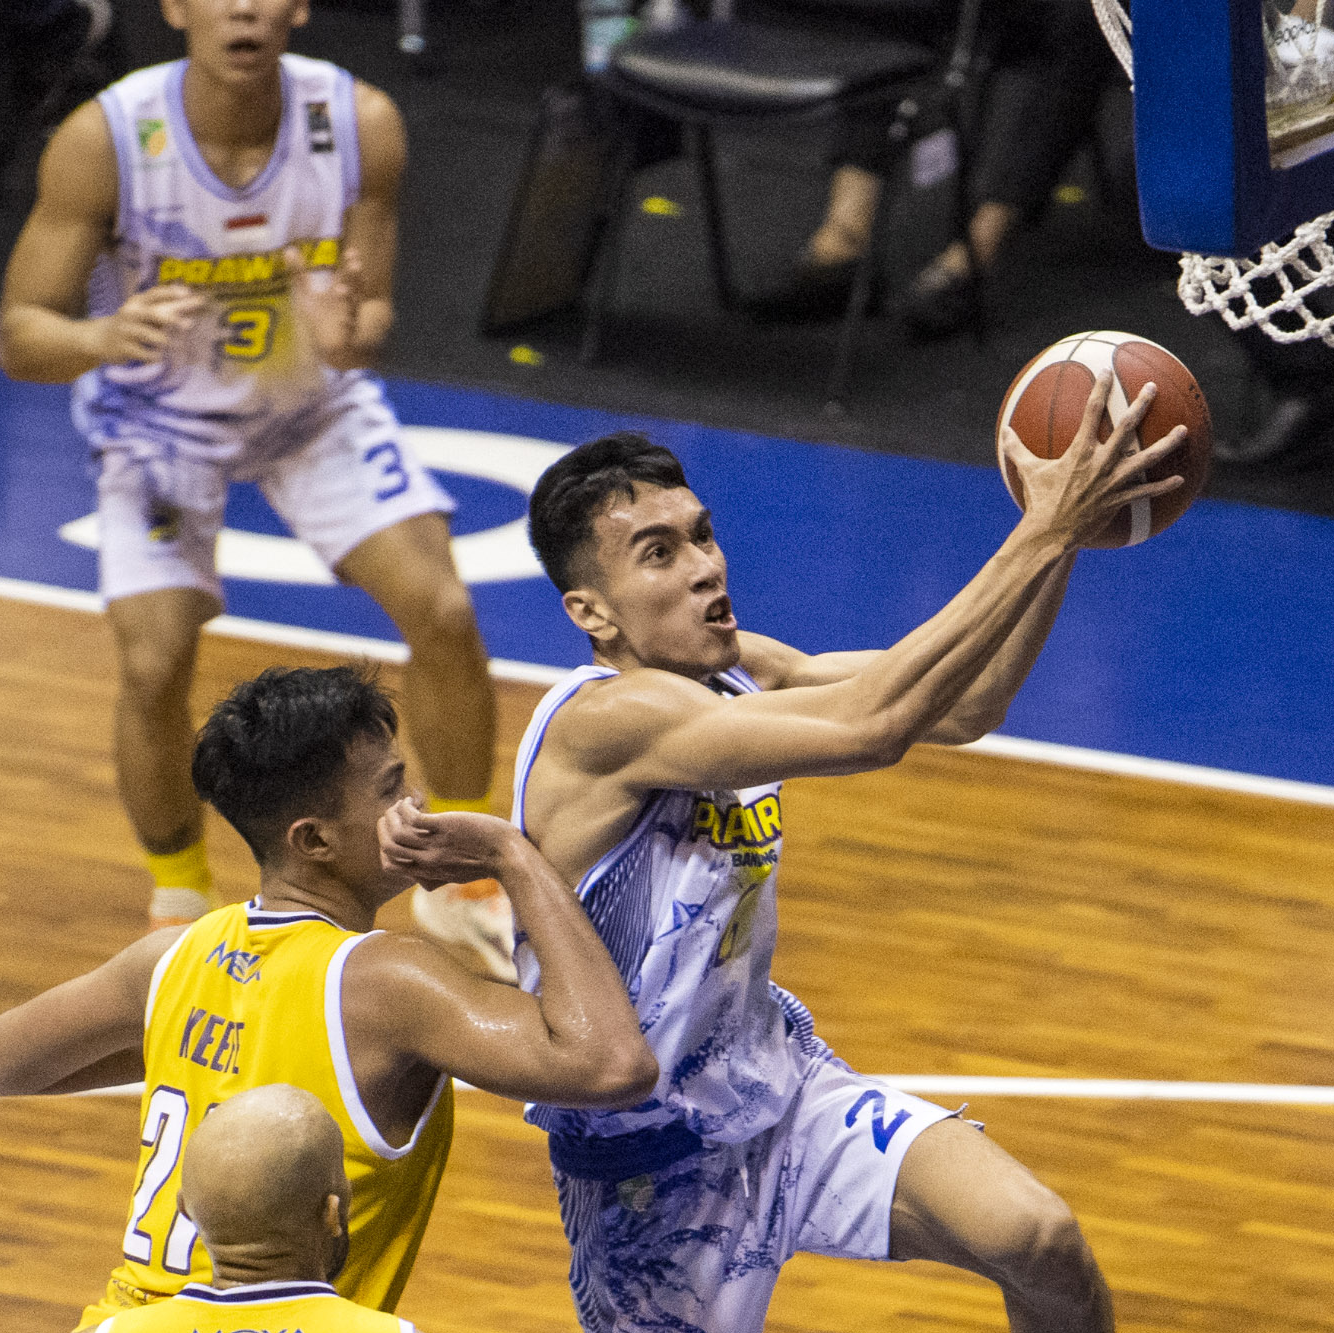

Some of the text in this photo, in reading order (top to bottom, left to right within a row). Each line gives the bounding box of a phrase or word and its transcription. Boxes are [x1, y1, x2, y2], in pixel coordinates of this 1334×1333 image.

[156, 237, 339, 284] PRAWA
[218, 304, 276, 363] 3
[364, 441, 409, 501] 3
[179, 1006, 245, 1075] KEE
[845, 1089, 913, 1154] 2
